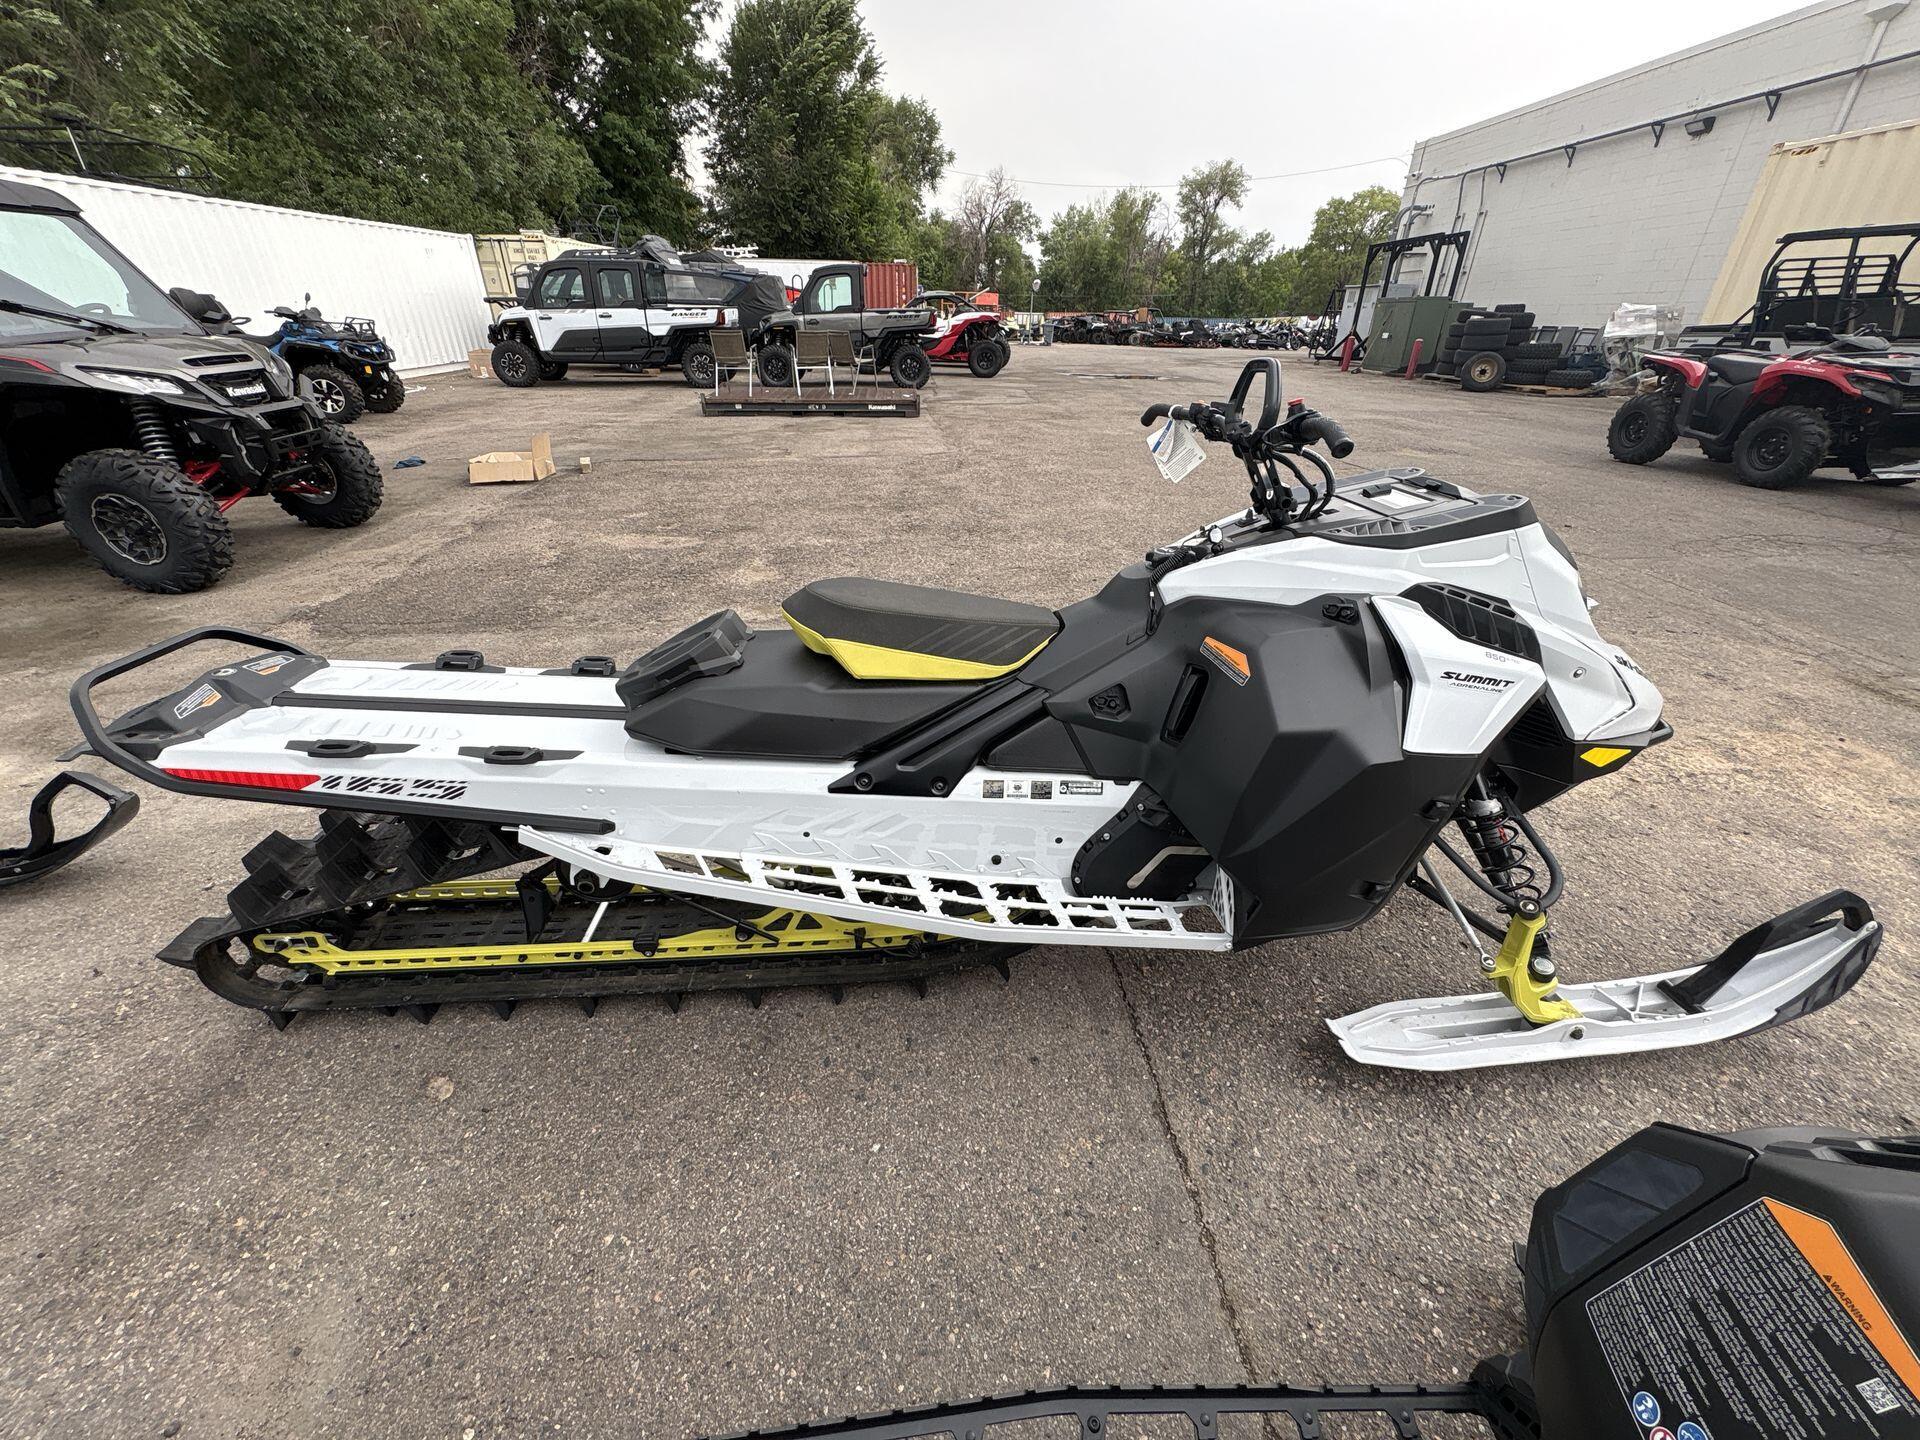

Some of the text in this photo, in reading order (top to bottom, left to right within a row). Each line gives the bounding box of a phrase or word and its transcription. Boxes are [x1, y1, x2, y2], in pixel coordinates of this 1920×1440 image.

[225, 382, 267, 397] Kawasaki
[1485, 651, 1506, 663] 850
[1440, 671, 1515, 688] SUMMIT
[1449, 682, 1504, 694] ADRENALINE
[1830, 1281, 1872, 1331] WARNING
